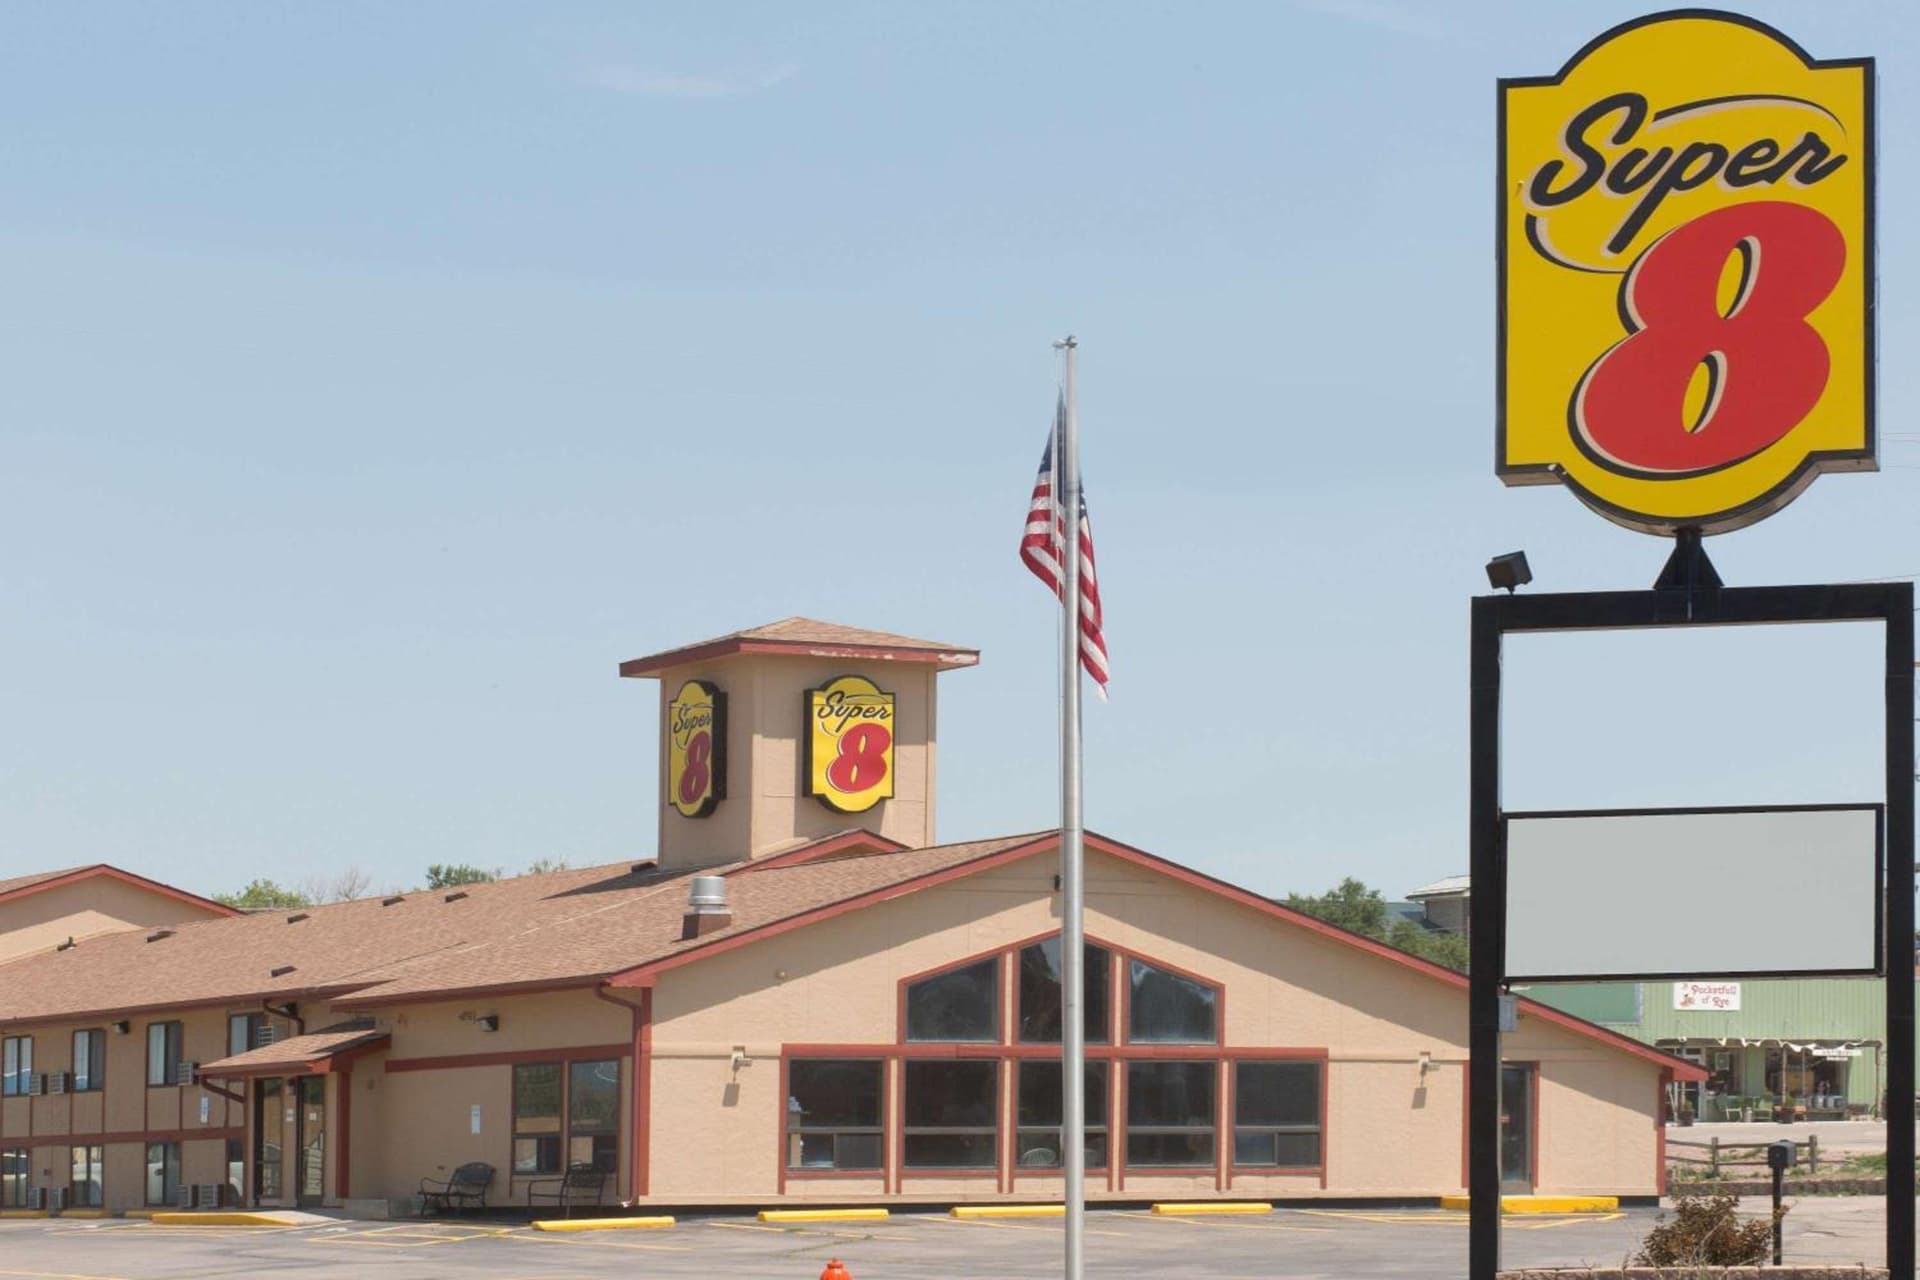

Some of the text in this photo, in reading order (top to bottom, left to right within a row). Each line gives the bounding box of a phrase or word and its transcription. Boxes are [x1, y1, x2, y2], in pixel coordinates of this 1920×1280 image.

[1526, 92, 1848, 258] Super
[1567, 200, 1847, 481] 8
[673, 704, 711, 747] Super
[817, 690, 892, 733] Super
[679, 731, 710, 804] 8
[826, 722, 891, 793] 8
